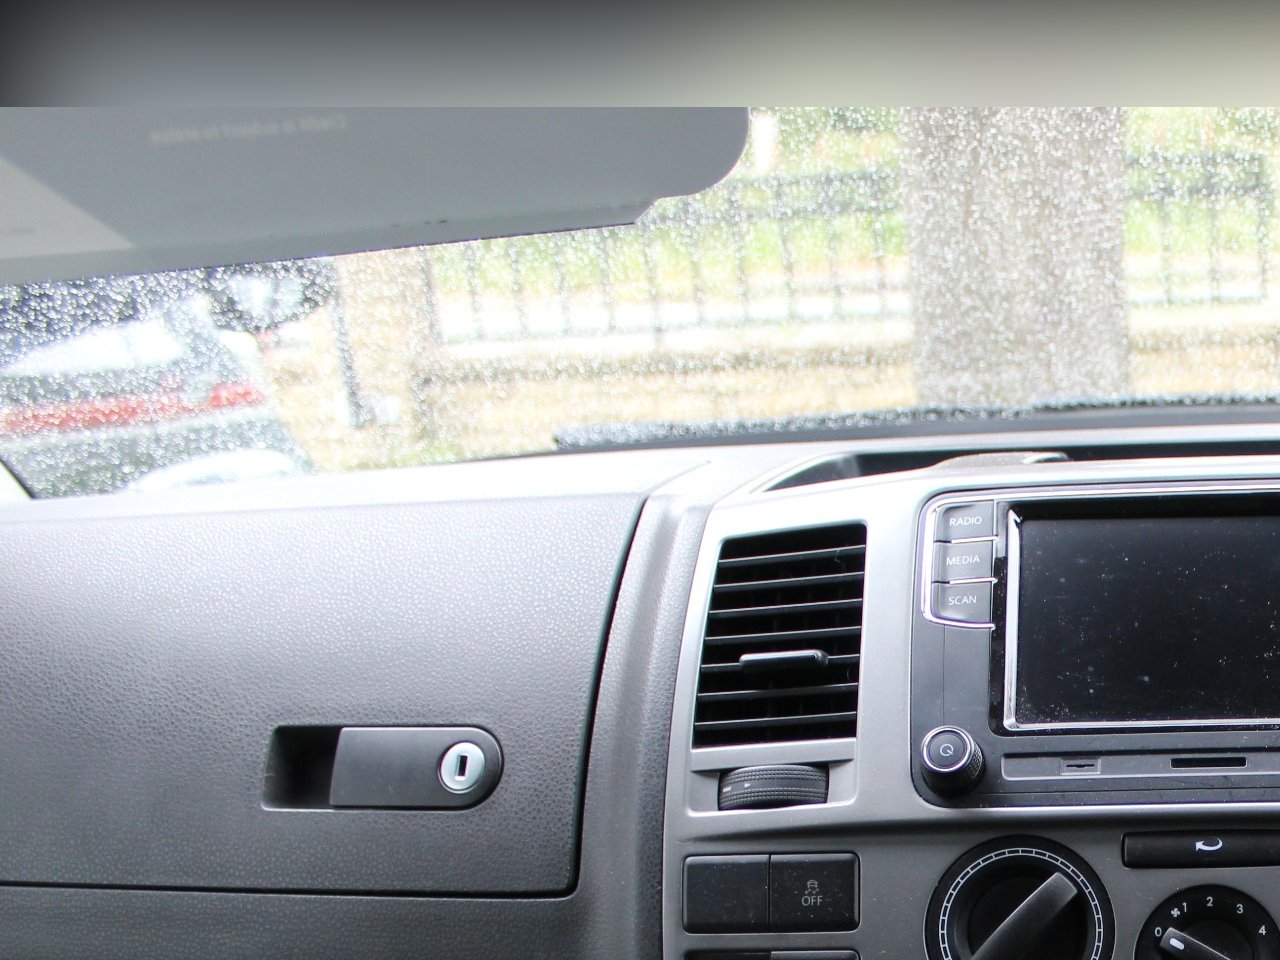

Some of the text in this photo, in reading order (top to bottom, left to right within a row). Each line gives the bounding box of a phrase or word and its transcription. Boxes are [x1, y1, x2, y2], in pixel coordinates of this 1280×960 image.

[949, 516, 982, 527] RADIO
[946, 555, 980, 566] MEDIA
[948, 595, 977, 606] SCAN
[801, 895, 823, 907] OFF
[1154, 896, 1267, 937] 0 1 2 3 4
